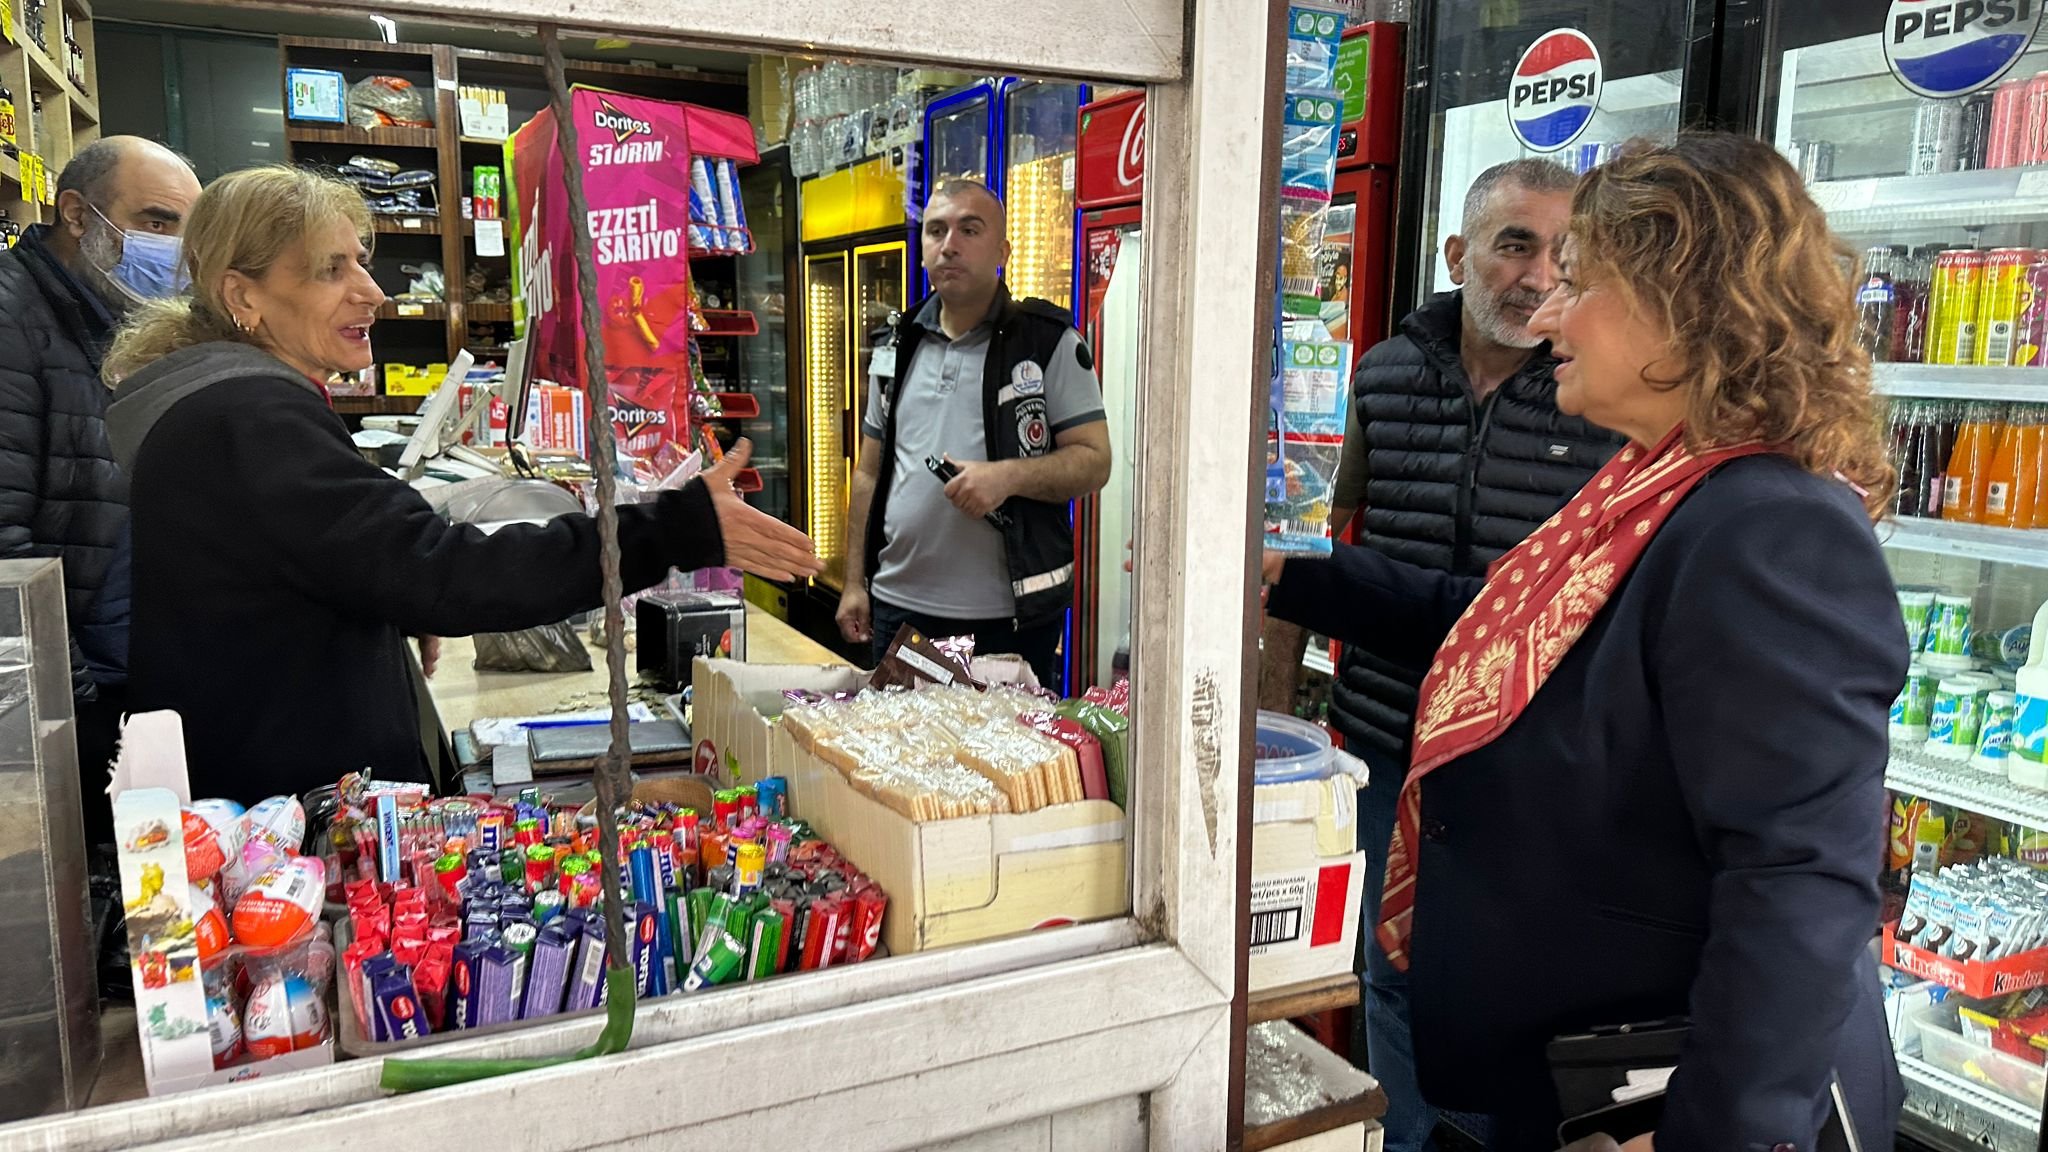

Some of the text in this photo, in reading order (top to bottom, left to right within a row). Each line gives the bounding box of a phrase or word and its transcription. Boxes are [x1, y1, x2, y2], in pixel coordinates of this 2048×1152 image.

[1893, 0, 2031, 44] PEPSI
[1514, 72, 1596, 109] PEPSI
[594, 110, 652, 135] Doritos
[589, 141, 663, 166] STORM
[607, 406, 667, 425] Doritos
[1289, 884, 1304, 896] 60g
[1894, 943, 1966, 992] Kinder
[1992, 968, 2046, 994] Kinder
